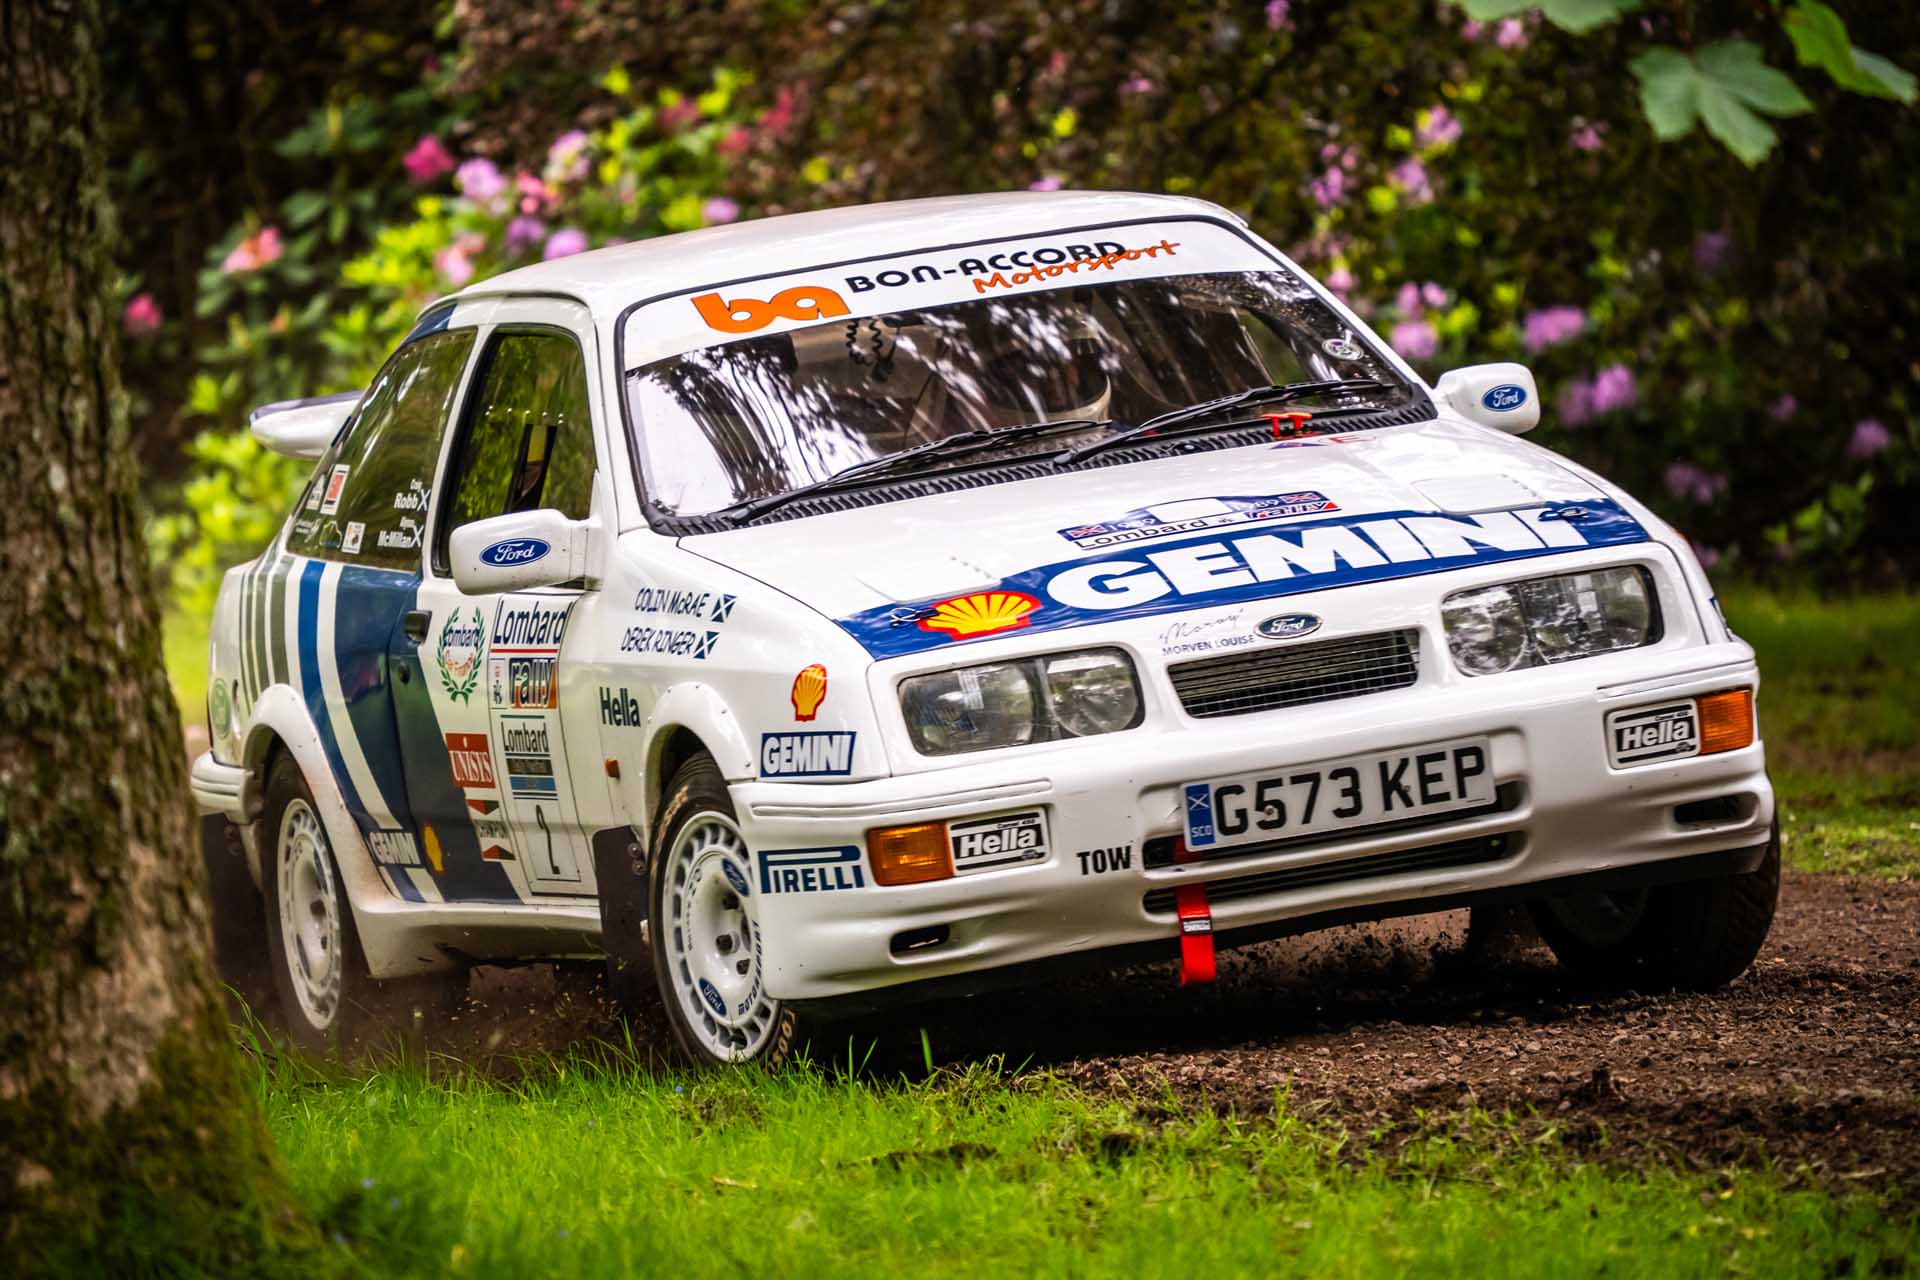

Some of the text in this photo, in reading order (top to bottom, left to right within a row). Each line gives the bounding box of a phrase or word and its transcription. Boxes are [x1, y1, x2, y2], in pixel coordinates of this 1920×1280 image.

[844, 242, 1126, 294] BON-ACCORD
[972, 239, 1181, 296] Motorsport
[690, 285, 852, 334] ba
[1074, 519, 1208, 549] Lombard
[1046, 509, 1589, 610] GEMINI
[493, 600, 573, 644] Lombard
[634, 587, 710, 617] COLIN McRAE
[620, 627, 698, 656] DEREK RINGER
[1162, 634, 1255, 656] MORVEN LOUISE
[511, 659, 554, 705] rally
[599, 686, 641, 728] Hella
[500, 721, 550, 753] Lombard
[762, 734, 852, 774] GEMINI
[1621, 720, 1690, 751] Hella
[1213, 745, 1486, 837] G573 KEP
[960, 828, 1037, 858] Hella
[1076, 845, 1132, 875] TOW
[757, 845, 865, 894] PIRELLI
